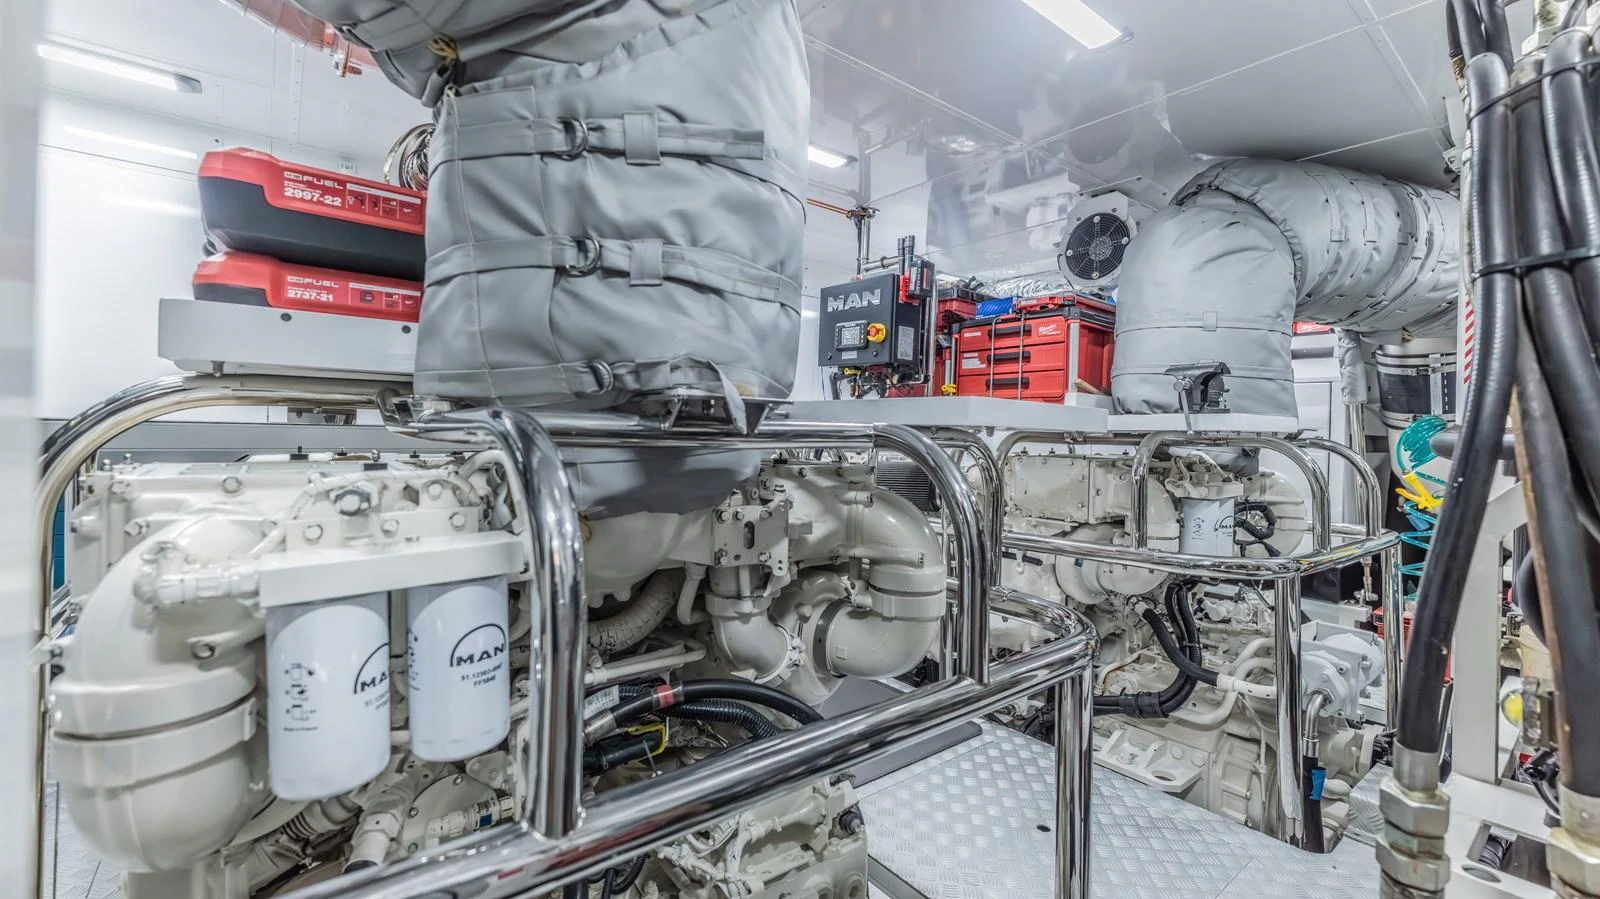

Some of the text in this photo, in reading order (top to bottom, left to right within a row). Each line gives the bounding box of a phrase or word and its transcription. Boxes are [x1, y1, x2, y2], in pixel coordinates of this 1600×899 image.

[303, 175, 344, 189] FUEL
[284, 187, 342, 207] 2997-22
[304, 278, 339, 288] FUEL
[287, 290, 334, 302] 2737-21
[827, 288, 881, 313] MAN
[456, 643, 504, 667] MAN
[360, 671, 388, 692] MA
